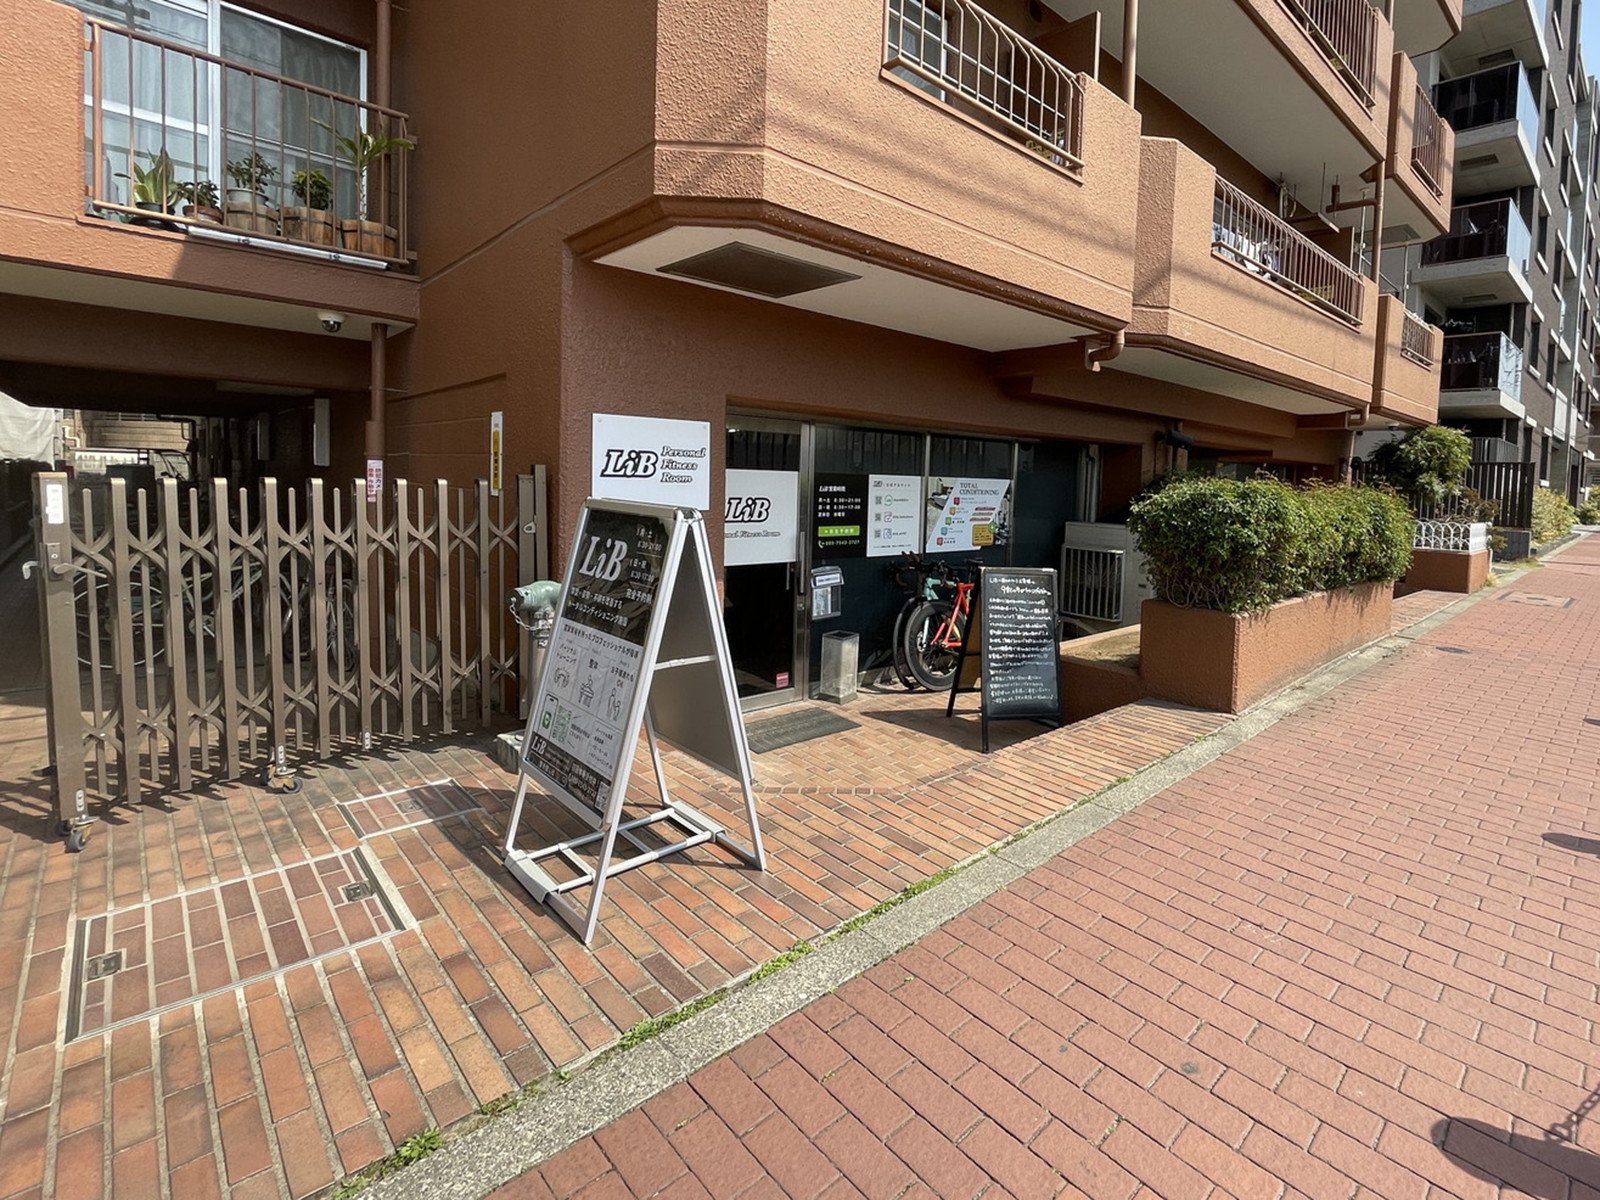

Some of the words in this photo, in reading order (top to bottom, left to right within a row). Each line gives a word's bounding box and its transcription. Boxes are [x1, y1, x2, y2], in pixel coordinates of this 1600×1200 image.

[660, 446, 706, 458] Personal
[600, 449, 659, 478] LiB
[660, 459, 698, 471] Fitness
[660, 472, 693, 483] Room
[725, 497, 771, 523] LiB
[579, 536, 628, 581] LiB
[531, 736, 547, 755] LiB
